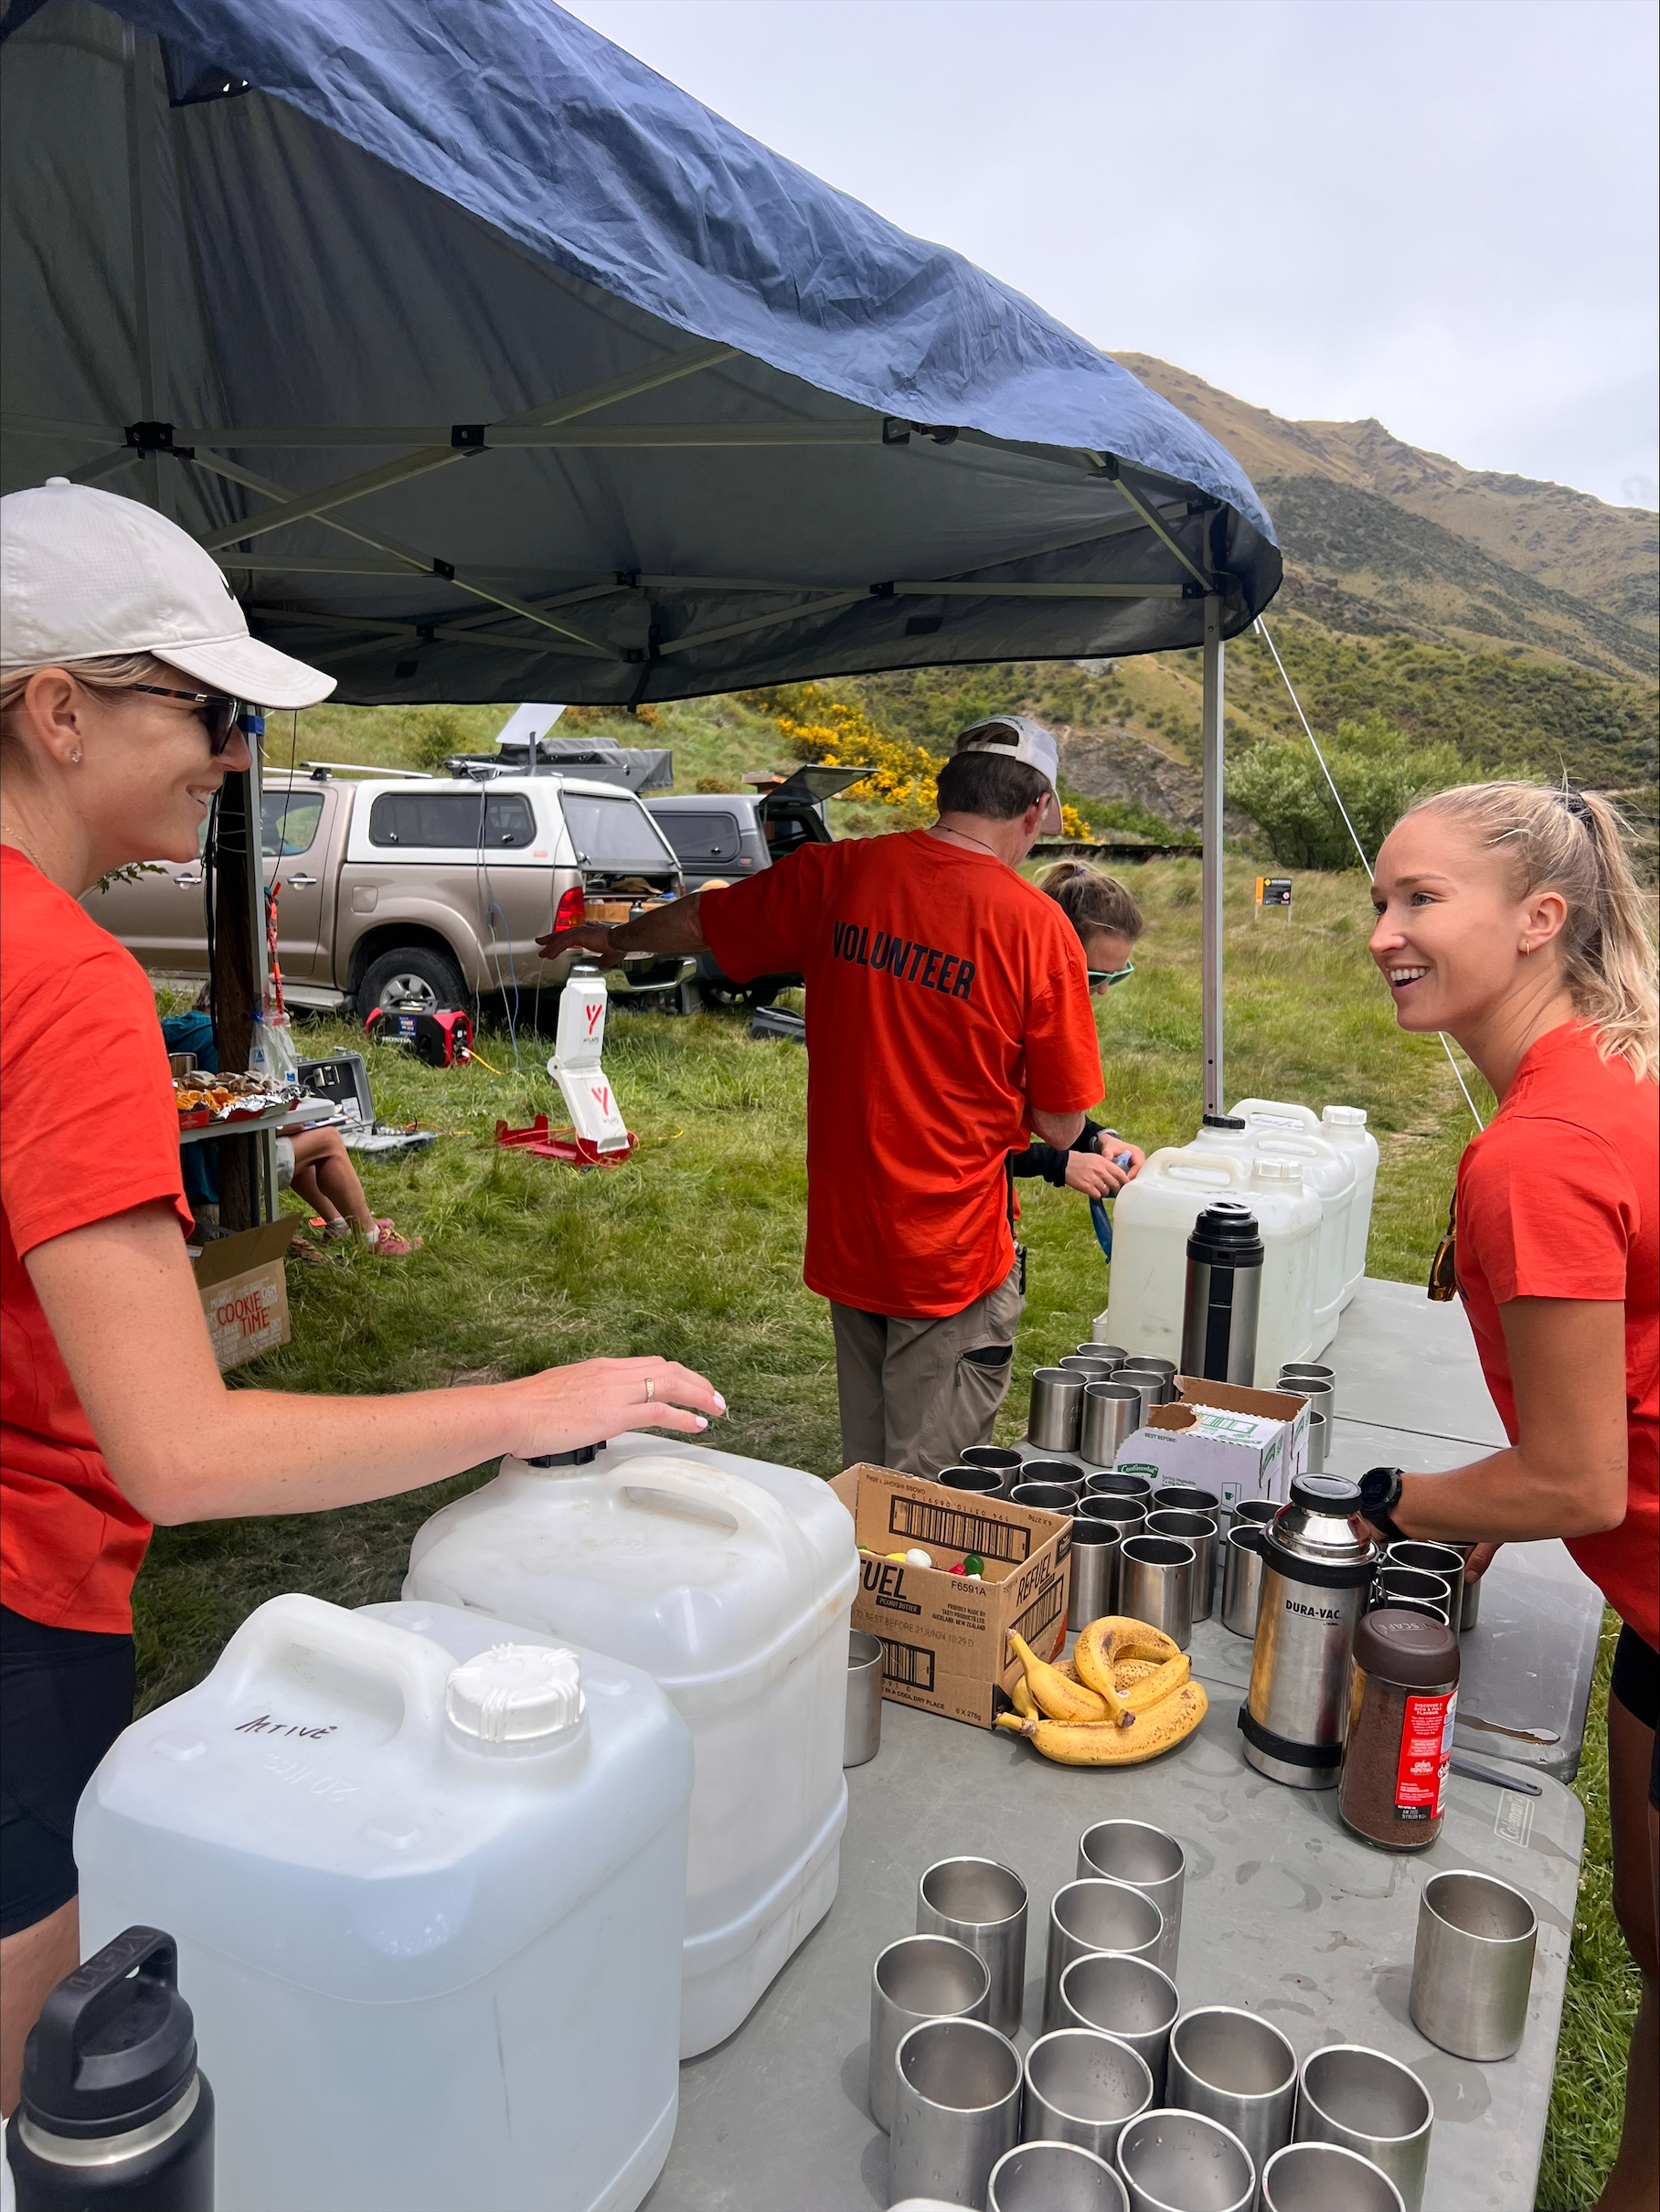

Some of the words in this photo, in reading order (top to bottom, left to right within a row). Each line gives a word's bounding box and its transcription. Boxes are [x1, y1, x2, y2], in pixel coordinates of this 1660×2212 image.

[834, 920, 975, 1000] VOLUNTEER
[217, 1291, 262, 1326] COOKIE
[240, 1306, 271, 1337] TIME
[883, 1479, 905, 1490] WEIGHT
[906, 1484, 926, 1495] GROSS
[956, 1504, 986, 1516] 03110
[993, 1513, 1009, 1522] 194
[951, 1580, 986, 1596] F6591A
[1016, 1552, 1051, 1608] REFUEL
[879, 1598, 899, 1609] PEANUT
[899, 1601, 919, 1612] BUTTER
[1285, 1599, 1339, 1620] DURA-VAC
[865, 1612, 883, 1624] BEST
[885, 1618, 914, 1632] BEFORE
[897, 1691, 913, 1701] COOL
[913, 1696, 926, 1705] DRY
[926, 1699, 945, 1710] PLACE
[966, 1711, 982, 1722] 275g
[1500, 1803, 1525, 1840] Coleman
